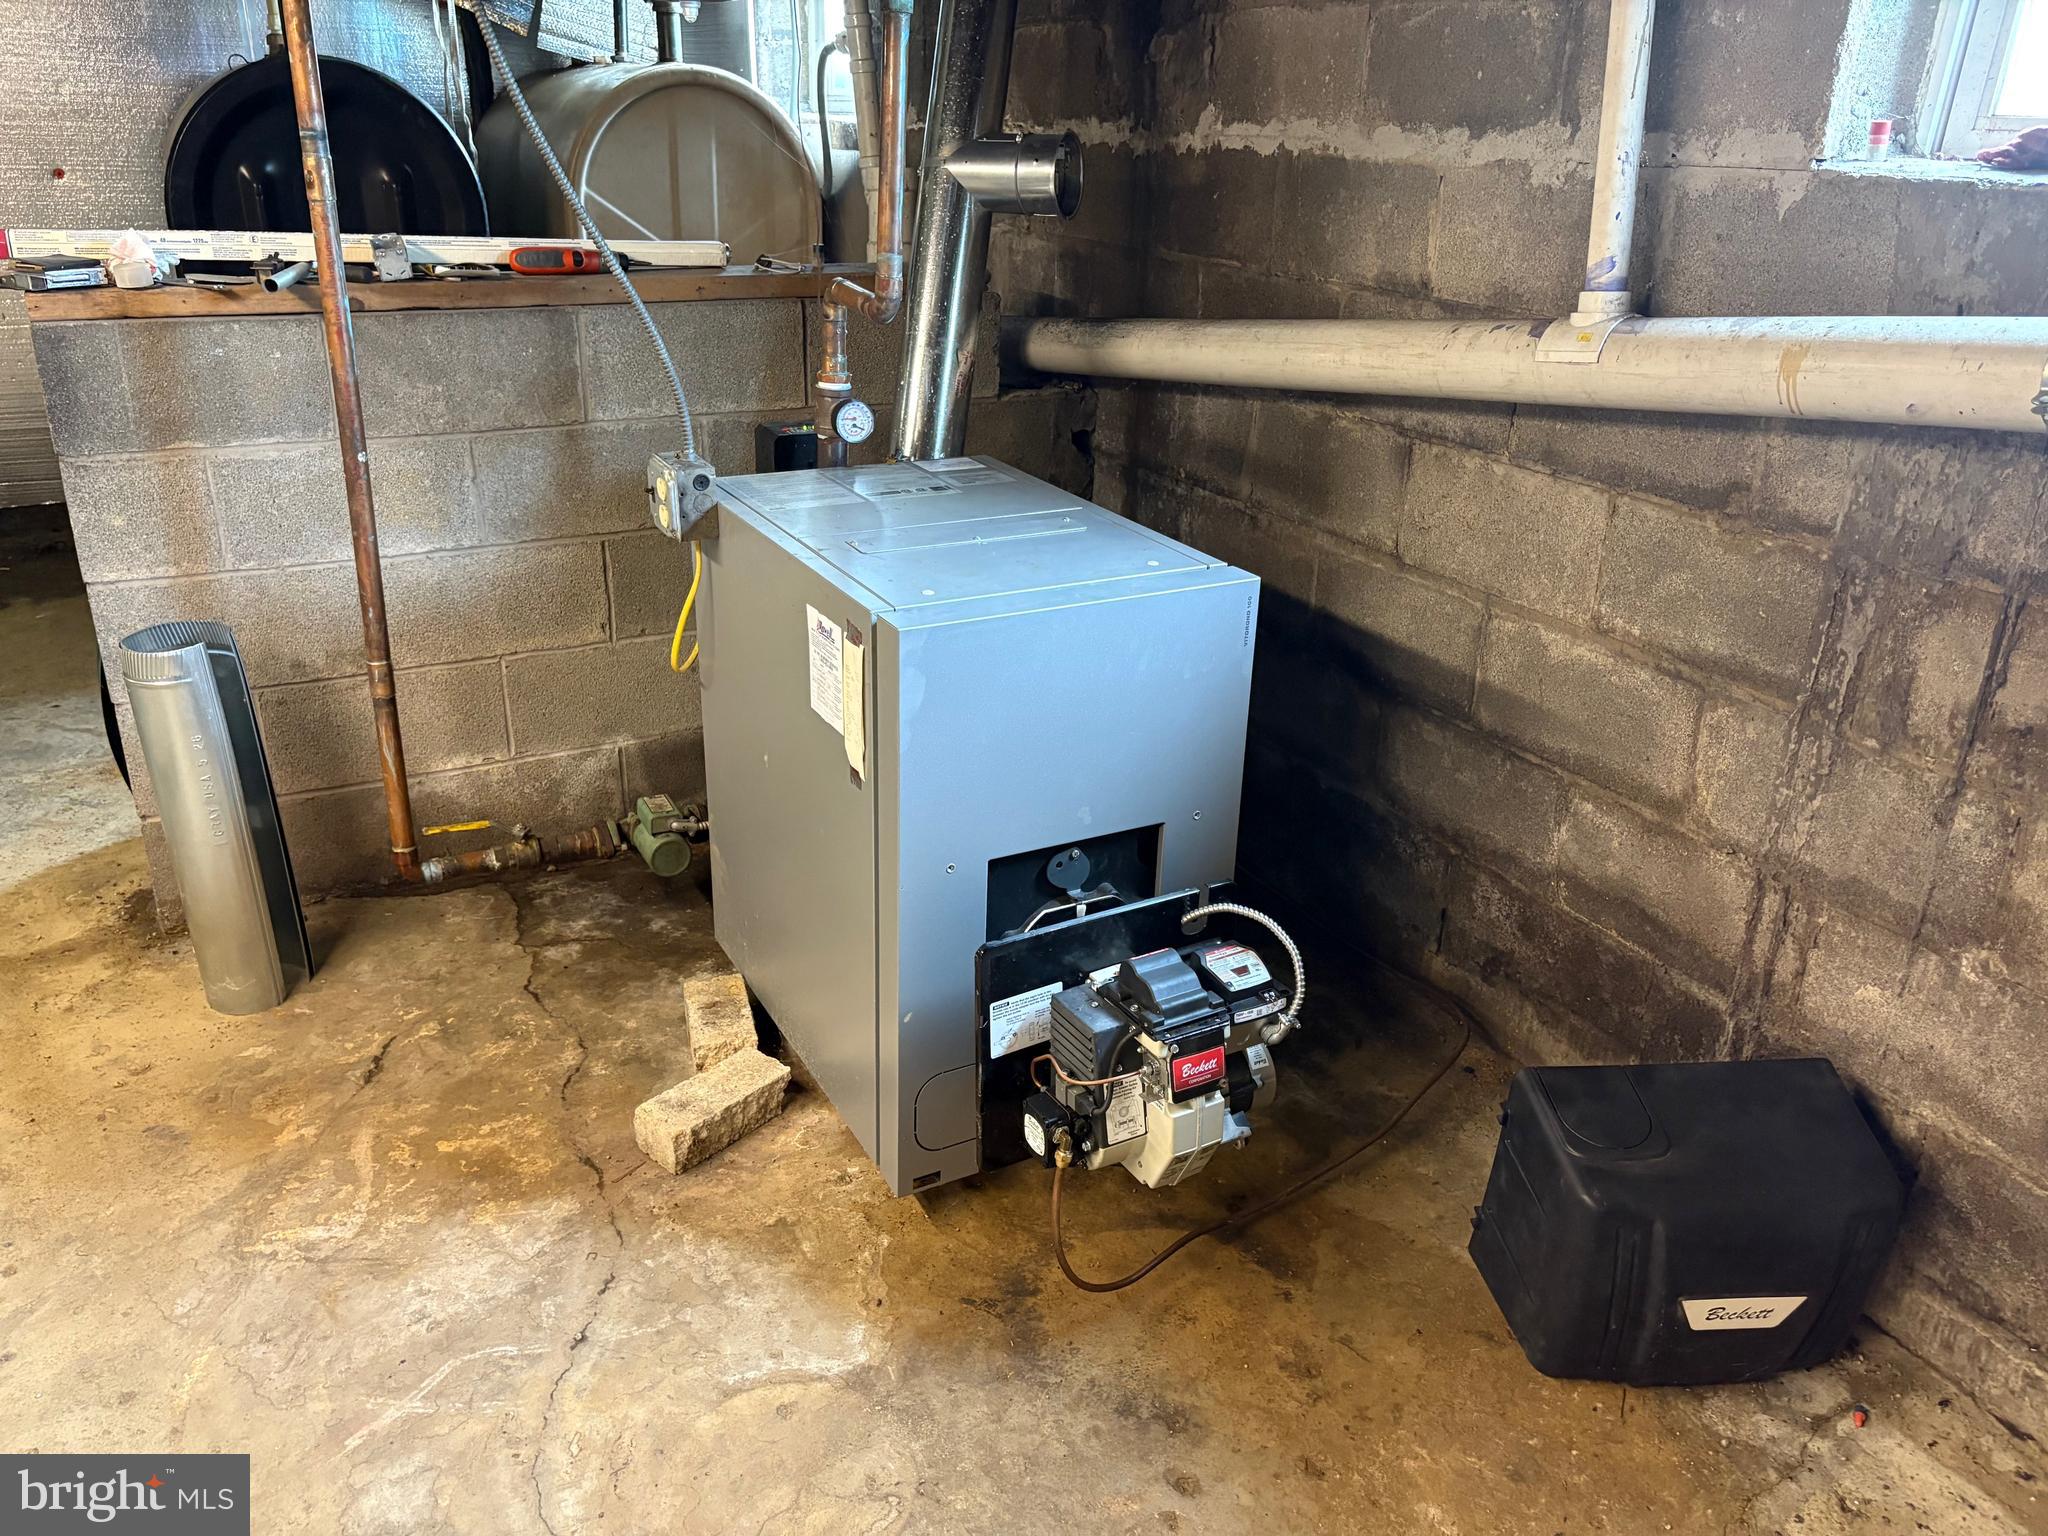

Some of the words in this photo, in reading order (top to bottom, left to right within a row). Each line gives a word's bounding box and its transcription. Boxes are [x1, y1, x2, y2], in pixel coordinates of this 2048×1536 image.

[200, 774, 216, 799] USA
[1181, 1057, 1218, 1078] Beckett
[1704, 1306, 1775, 1321] Beckett
